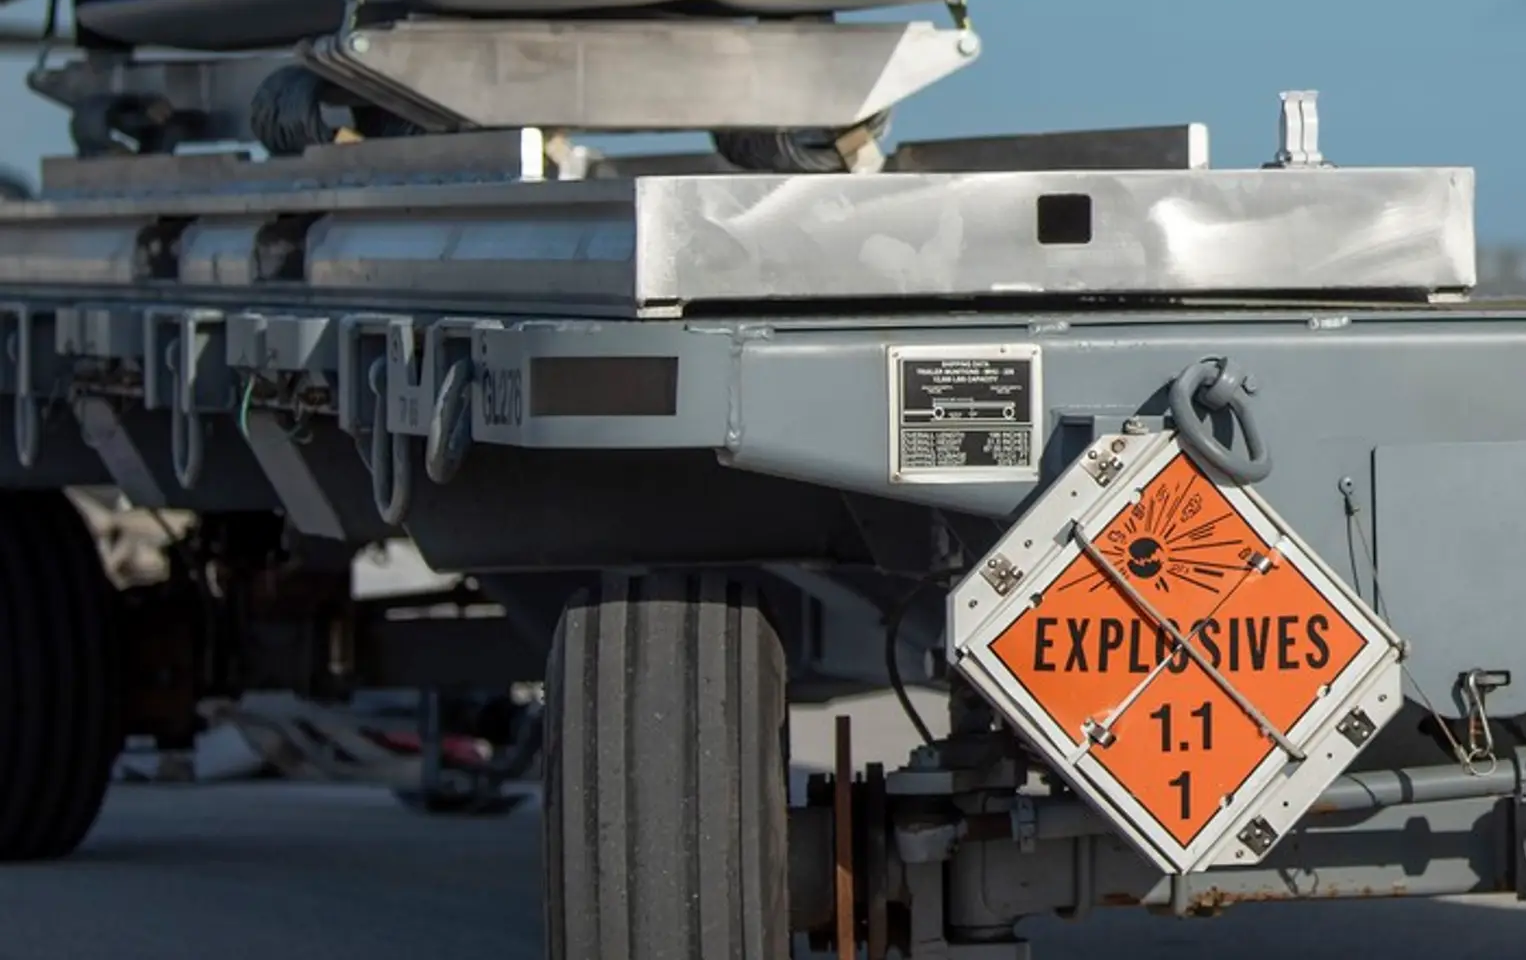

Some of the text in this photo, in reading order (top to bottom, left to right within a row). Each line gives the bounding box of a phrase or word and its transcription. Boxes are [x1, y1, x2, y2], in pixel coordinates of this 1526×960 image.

[482, 368, 523, 426] GL276
[1033, 615, 1330, 675] EXPLOSIVES
[1150, 702, 1214, 753] 1.1
[1168, 770, 1192, 821] 1
